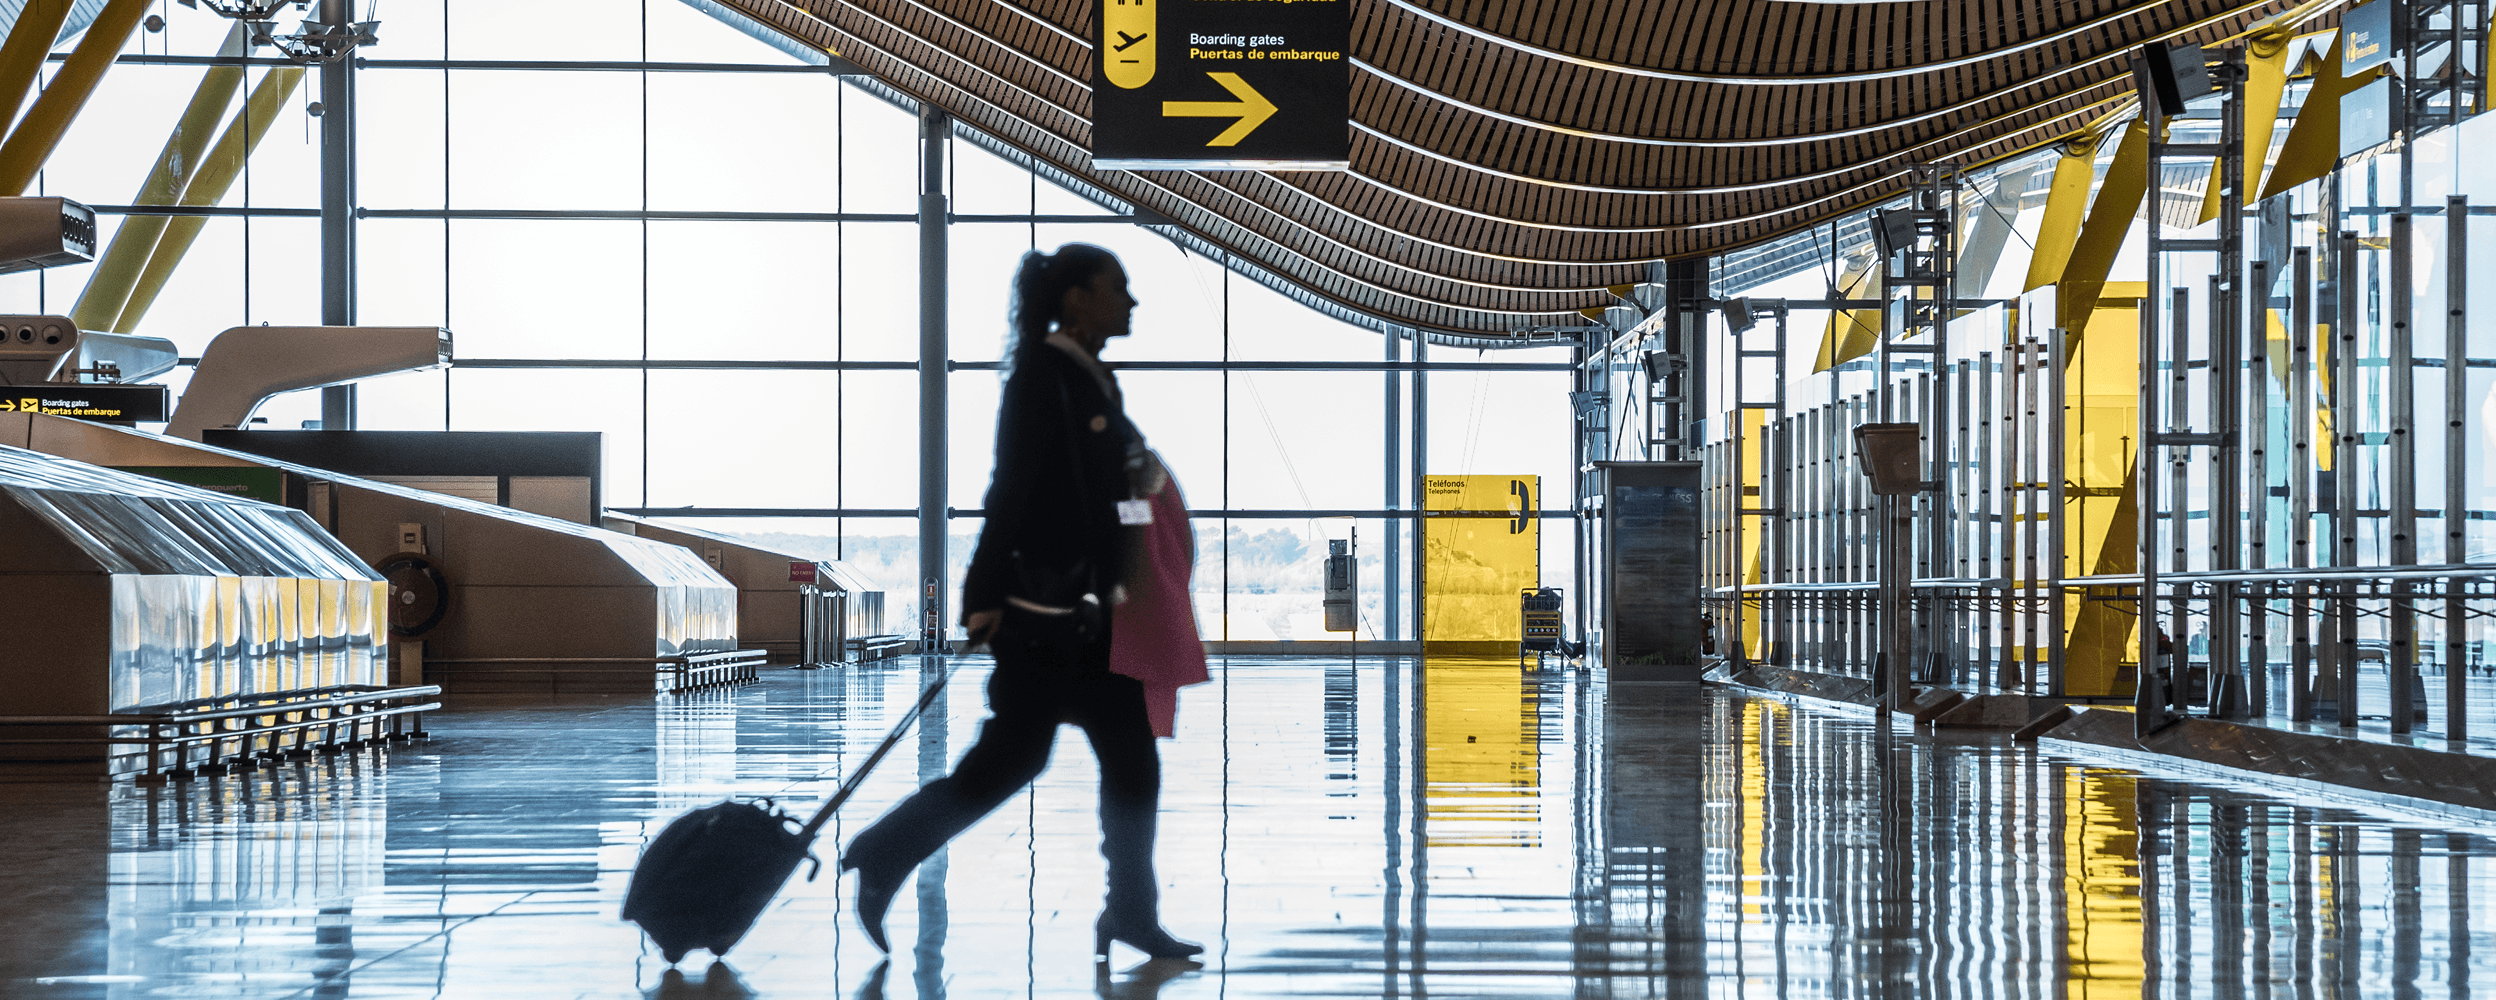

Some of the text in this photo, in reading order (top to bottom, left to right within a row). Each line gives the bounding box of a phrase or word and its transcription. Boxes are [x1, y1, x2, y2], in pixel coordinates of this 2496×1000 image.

[1190, 33, 1285, 47] Boarding gates
[1190, 48, 1340, 62] Puertas de embarque
[42, 399, 89, 408] Boarding gates
[42, 407, 121, 417] Puertas de embarque
[1428, 479, 1465, 488] Teléfonos
